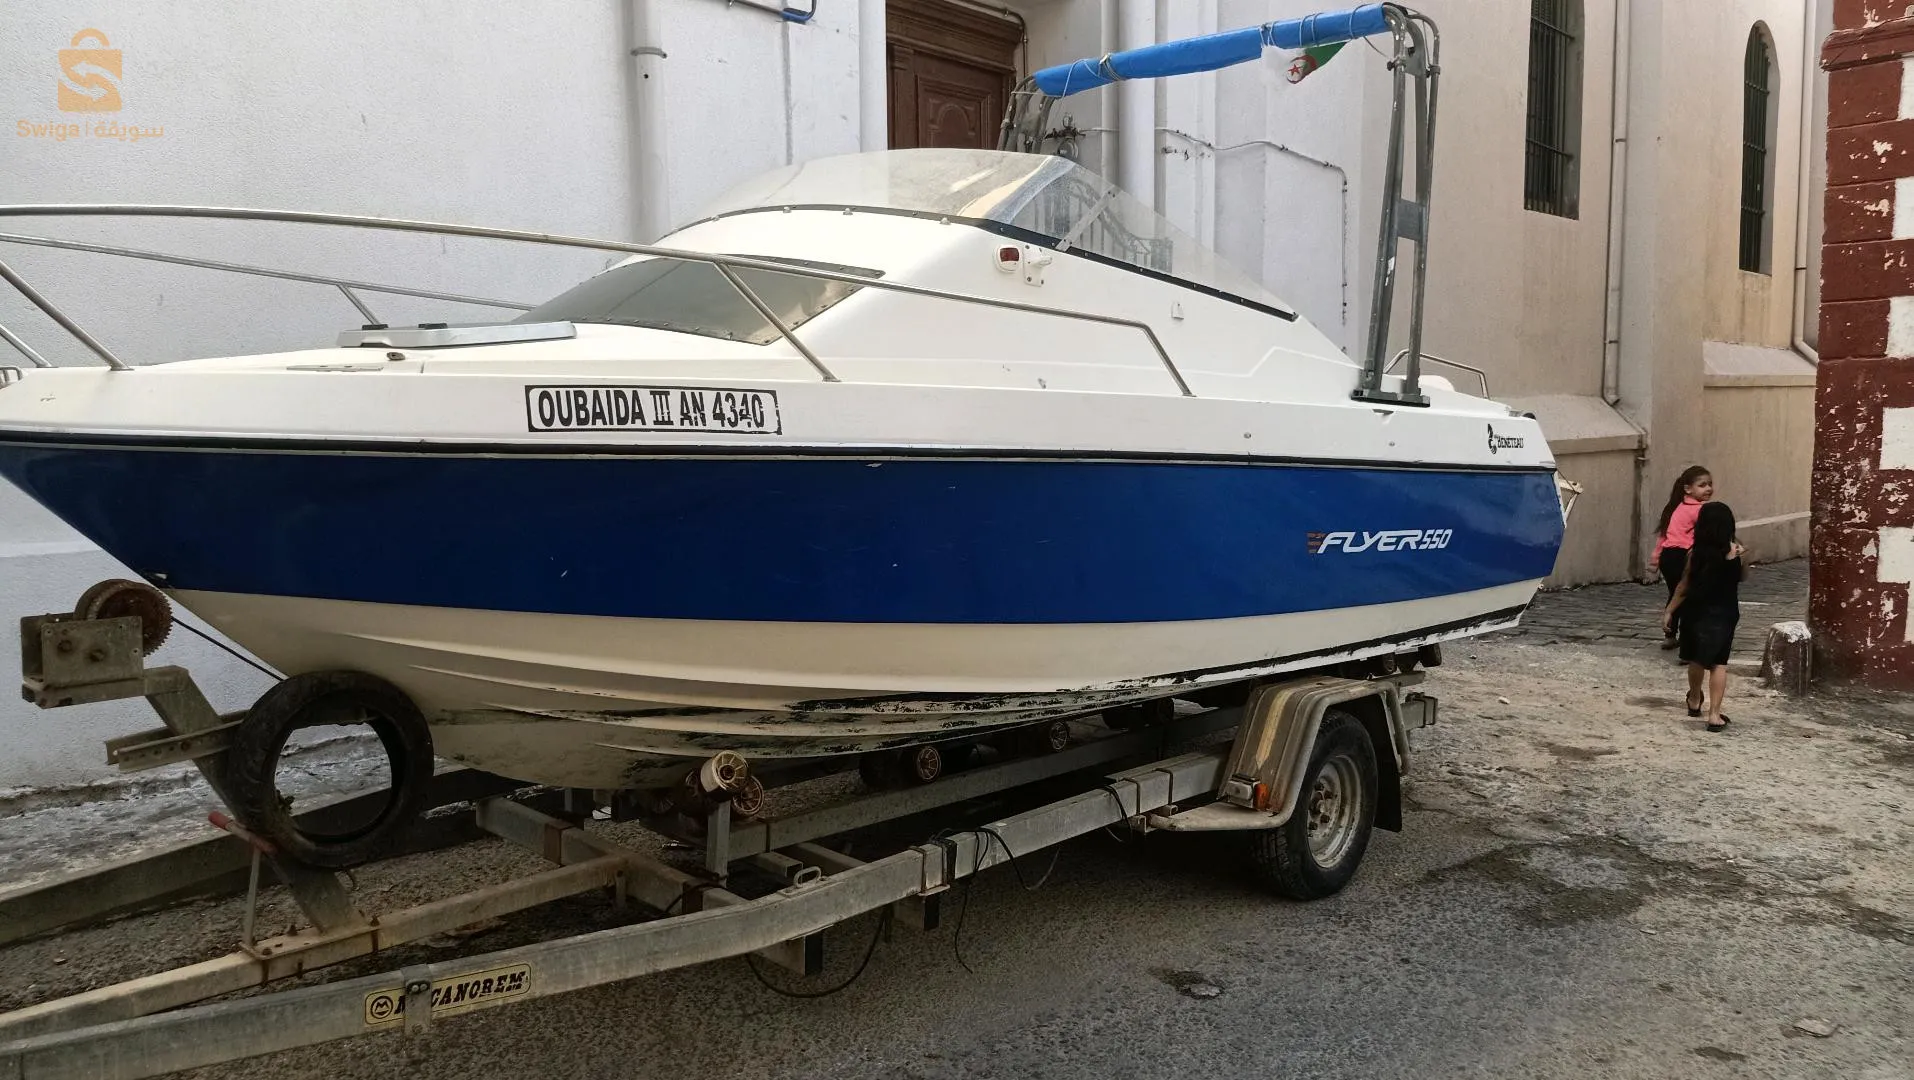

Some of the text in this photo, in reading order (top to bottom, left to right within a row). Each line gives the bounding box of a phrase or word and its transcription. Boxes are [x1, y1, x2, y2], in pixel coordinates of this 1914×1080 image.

[538, 389, 764, 428] OUBAIDA III AN 4340
[1316, 528, 1453, 554] FLYER 550
[394, 971, 527, 1015] CANOREM
